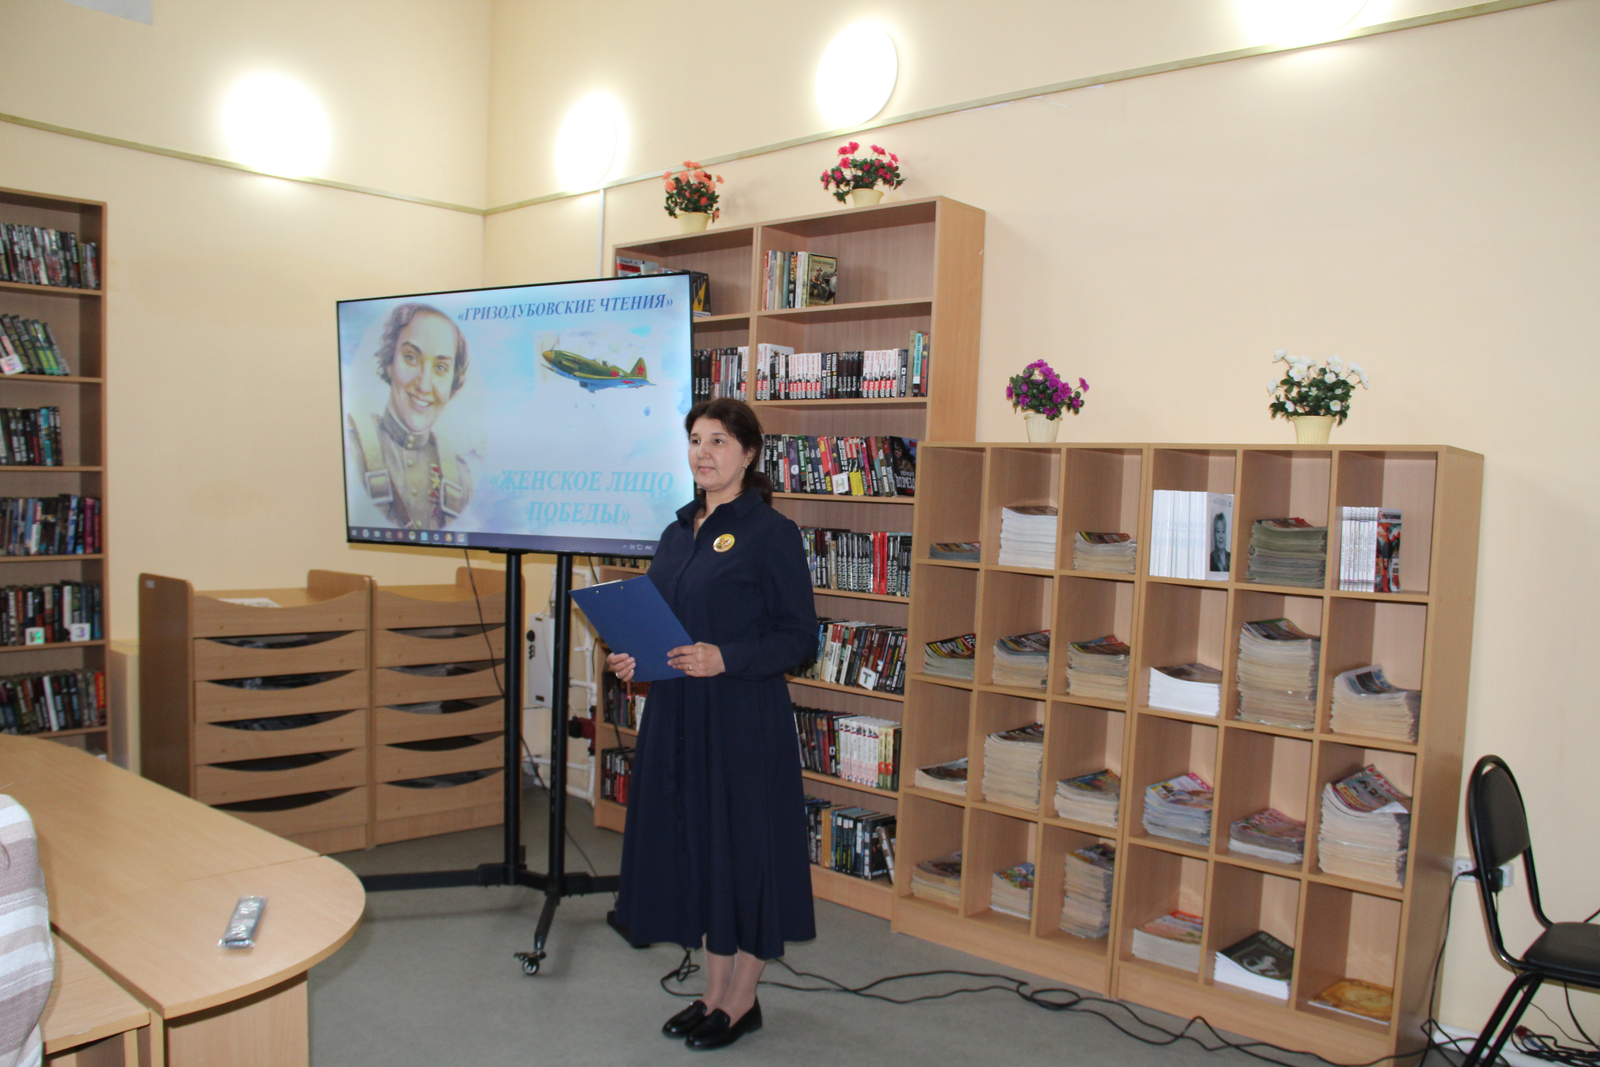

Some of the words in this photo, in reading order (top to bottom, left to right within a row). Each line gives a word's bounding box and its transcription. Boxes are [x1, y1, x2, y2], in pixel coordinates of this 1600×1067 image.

[457, 298, 596, 322] «ГРИЗОДУБОВСКИЕ
[599, 293, 674, 312] ЧТЕНИЯ»
[490, 469, 604, 493] «ЖЕНСКОЕ
[605, 471, 674, 495] ЛИЦО
[526, 500, 631, 525] ПОБЕДЫ»
